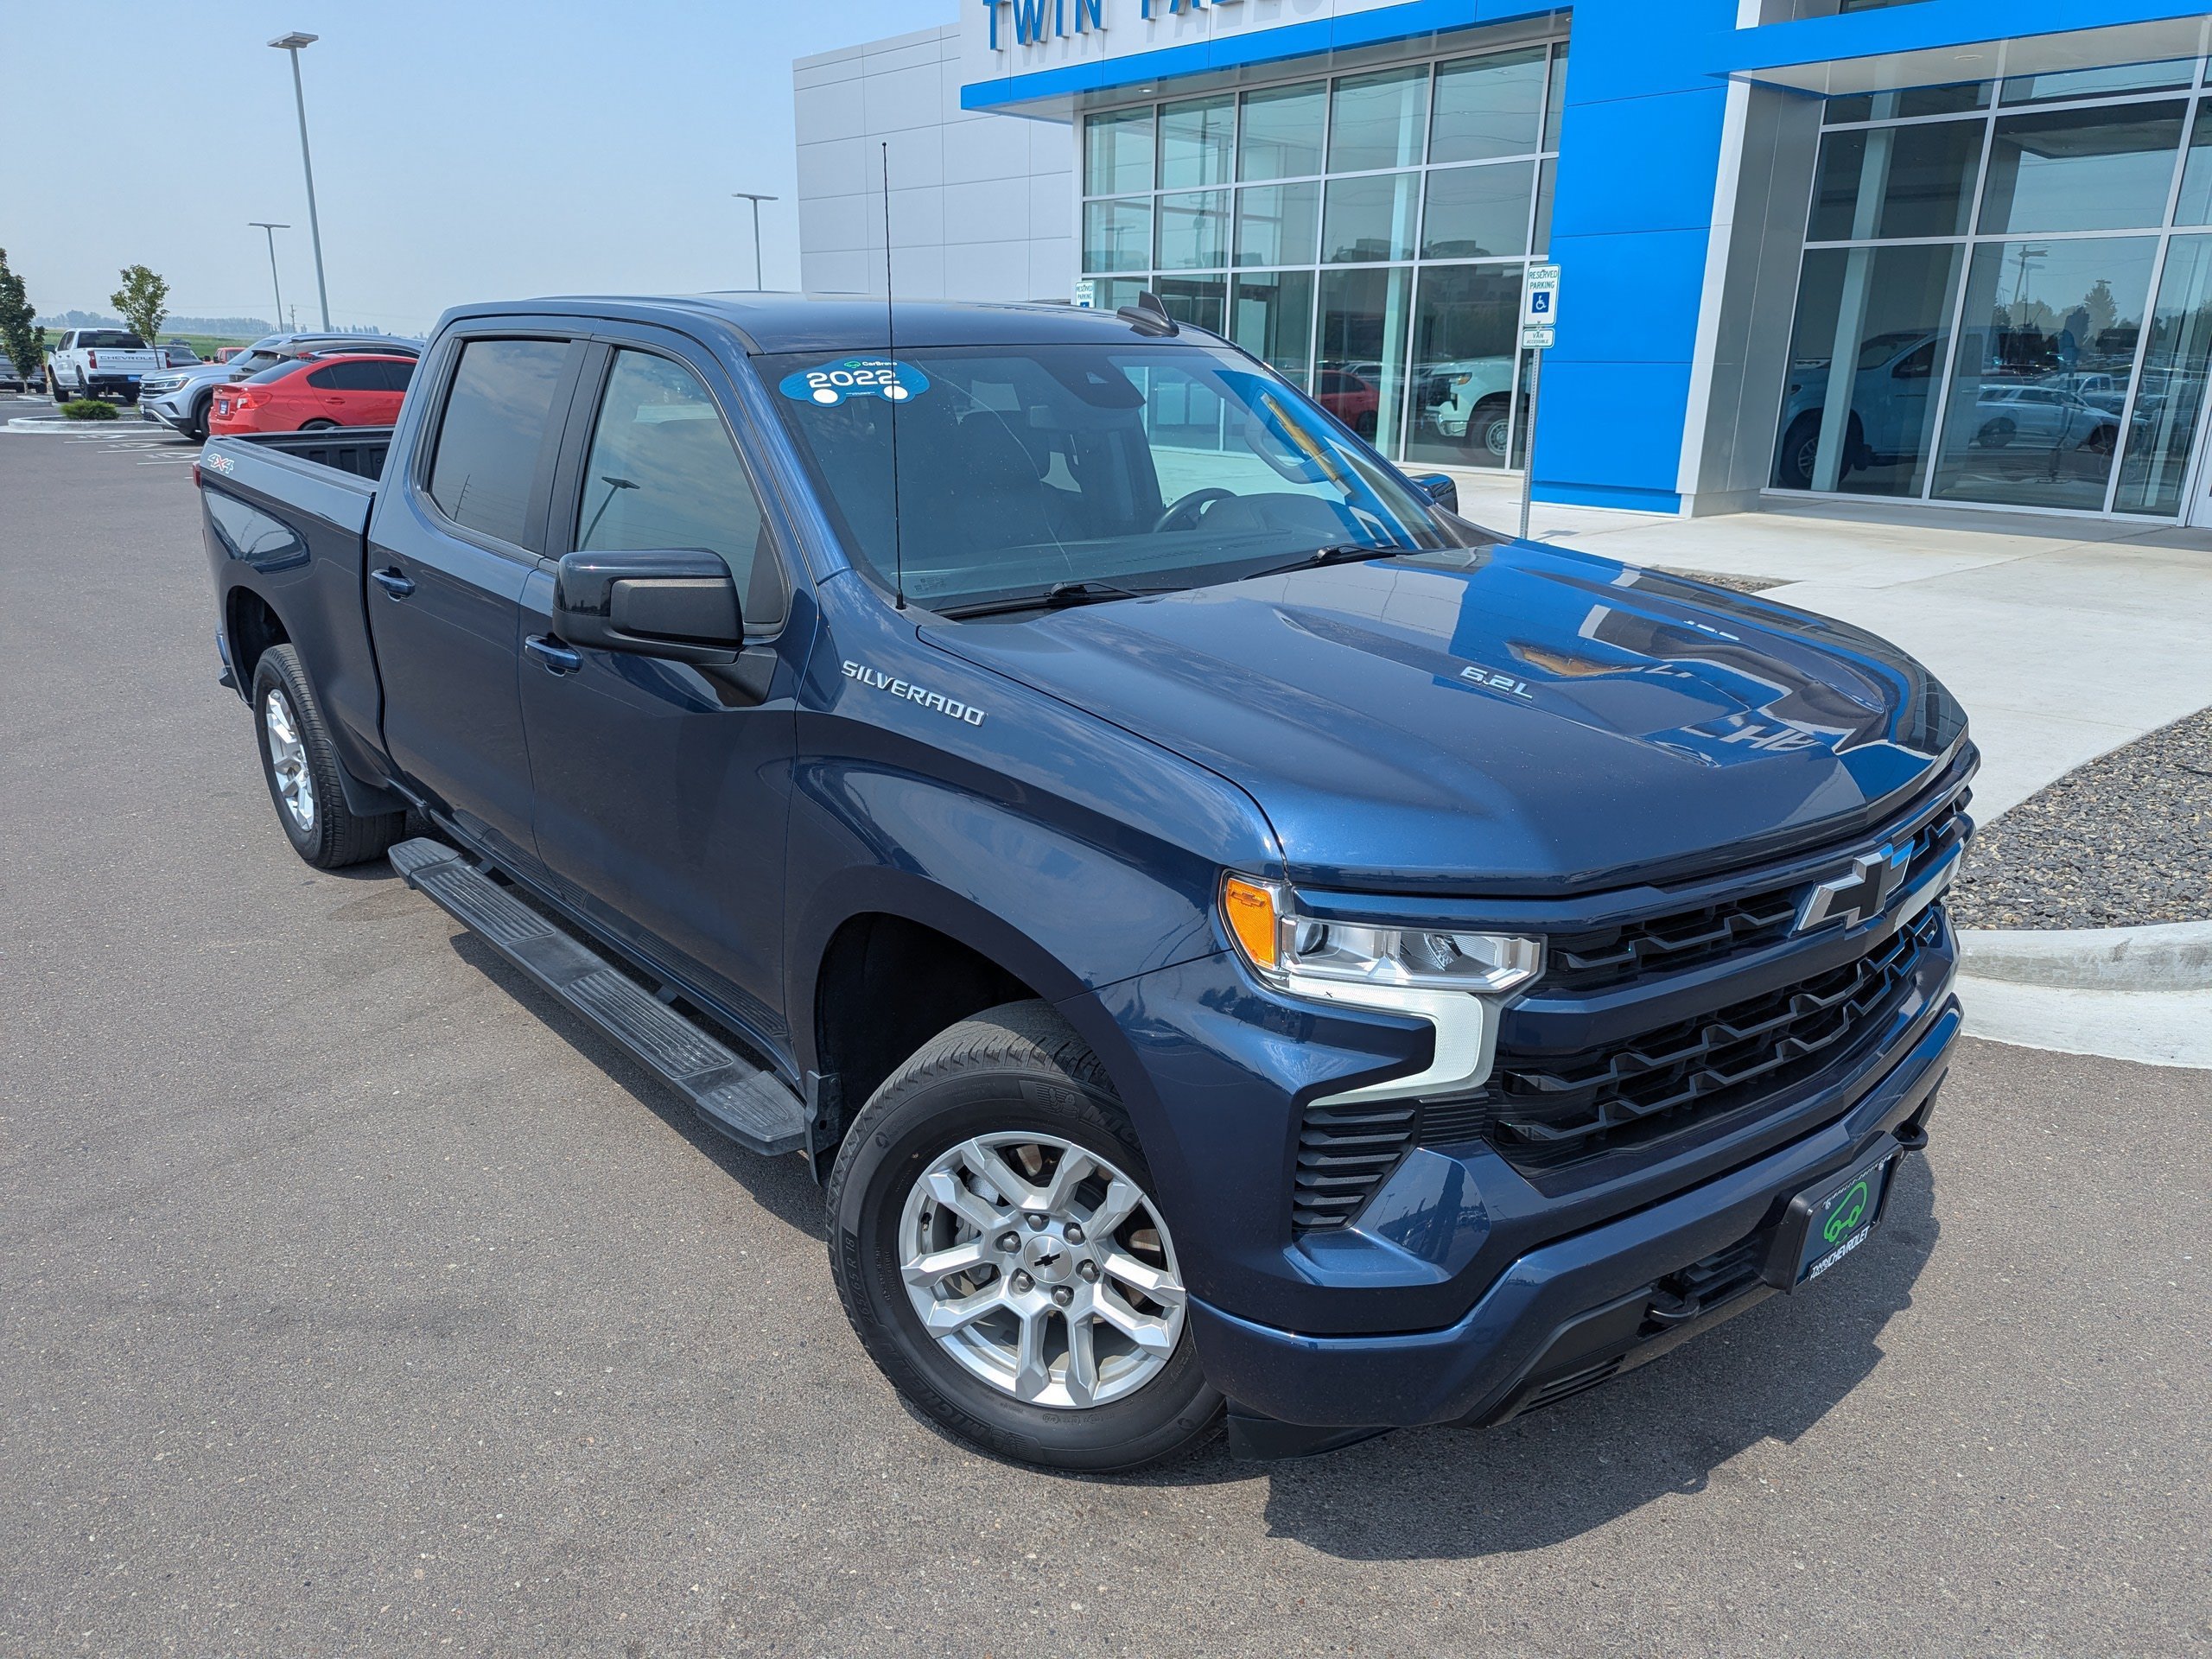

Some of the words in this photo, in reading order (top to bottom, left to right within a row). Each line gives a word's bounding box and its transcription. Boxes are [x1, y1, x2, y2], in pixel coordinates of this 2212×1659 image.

[982, 0, 1108, 51] TWIN
[1529, 270, 1558, 279] RESERVED
[1529, 281, 1555, 289] PARKING
[806, 369, 901, 389] 2022
[841, 659, 986, 727] SILVERADO
[1459, 665, 1534, 701] 6.2L
[845, 1236, 855, 1252] 18
[1827, 1225, 1871, 1268] CHEVROLET
[846, 1257, 857, 1268] R
